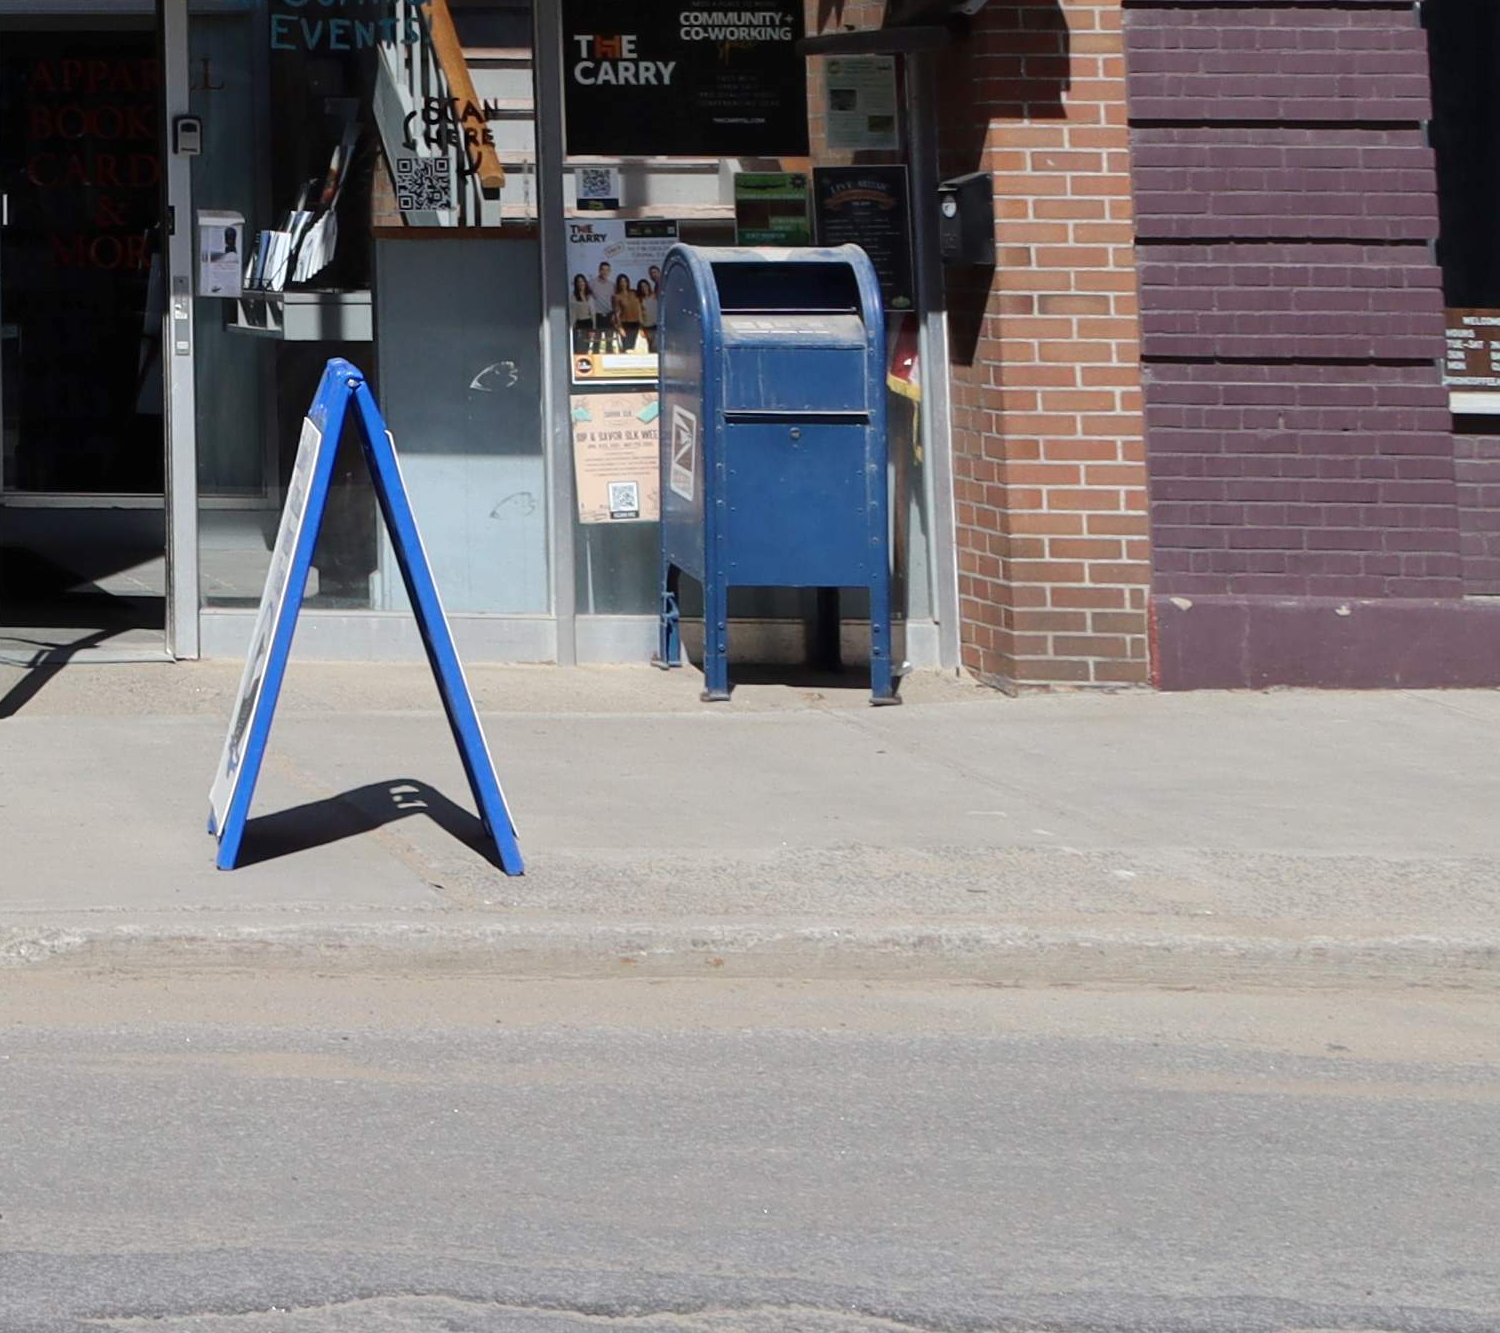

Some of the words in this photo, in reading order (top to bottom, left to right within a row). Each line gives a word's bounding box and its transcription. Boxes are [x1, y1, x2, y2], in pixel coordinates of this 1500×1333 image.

[270, 13, 433, 52] EVENTS!
[679, 26, 793, 41] CO-WORKING
[573, 34, 639, 60] THE
[28, 57, 224, 93] APPARL
[573, 61, 677, 86] CARRY
[28, 103, 159, 141] BOOK
[422, 96, 498, 124] SCAN
[423, 128, 496, 151] HERE
[28, 151, 160, 189] CARD
[570, 224, 594, 234] THE
[570, 234, 607, 244] CARRY
[50, 234, 151, 270] MOR
